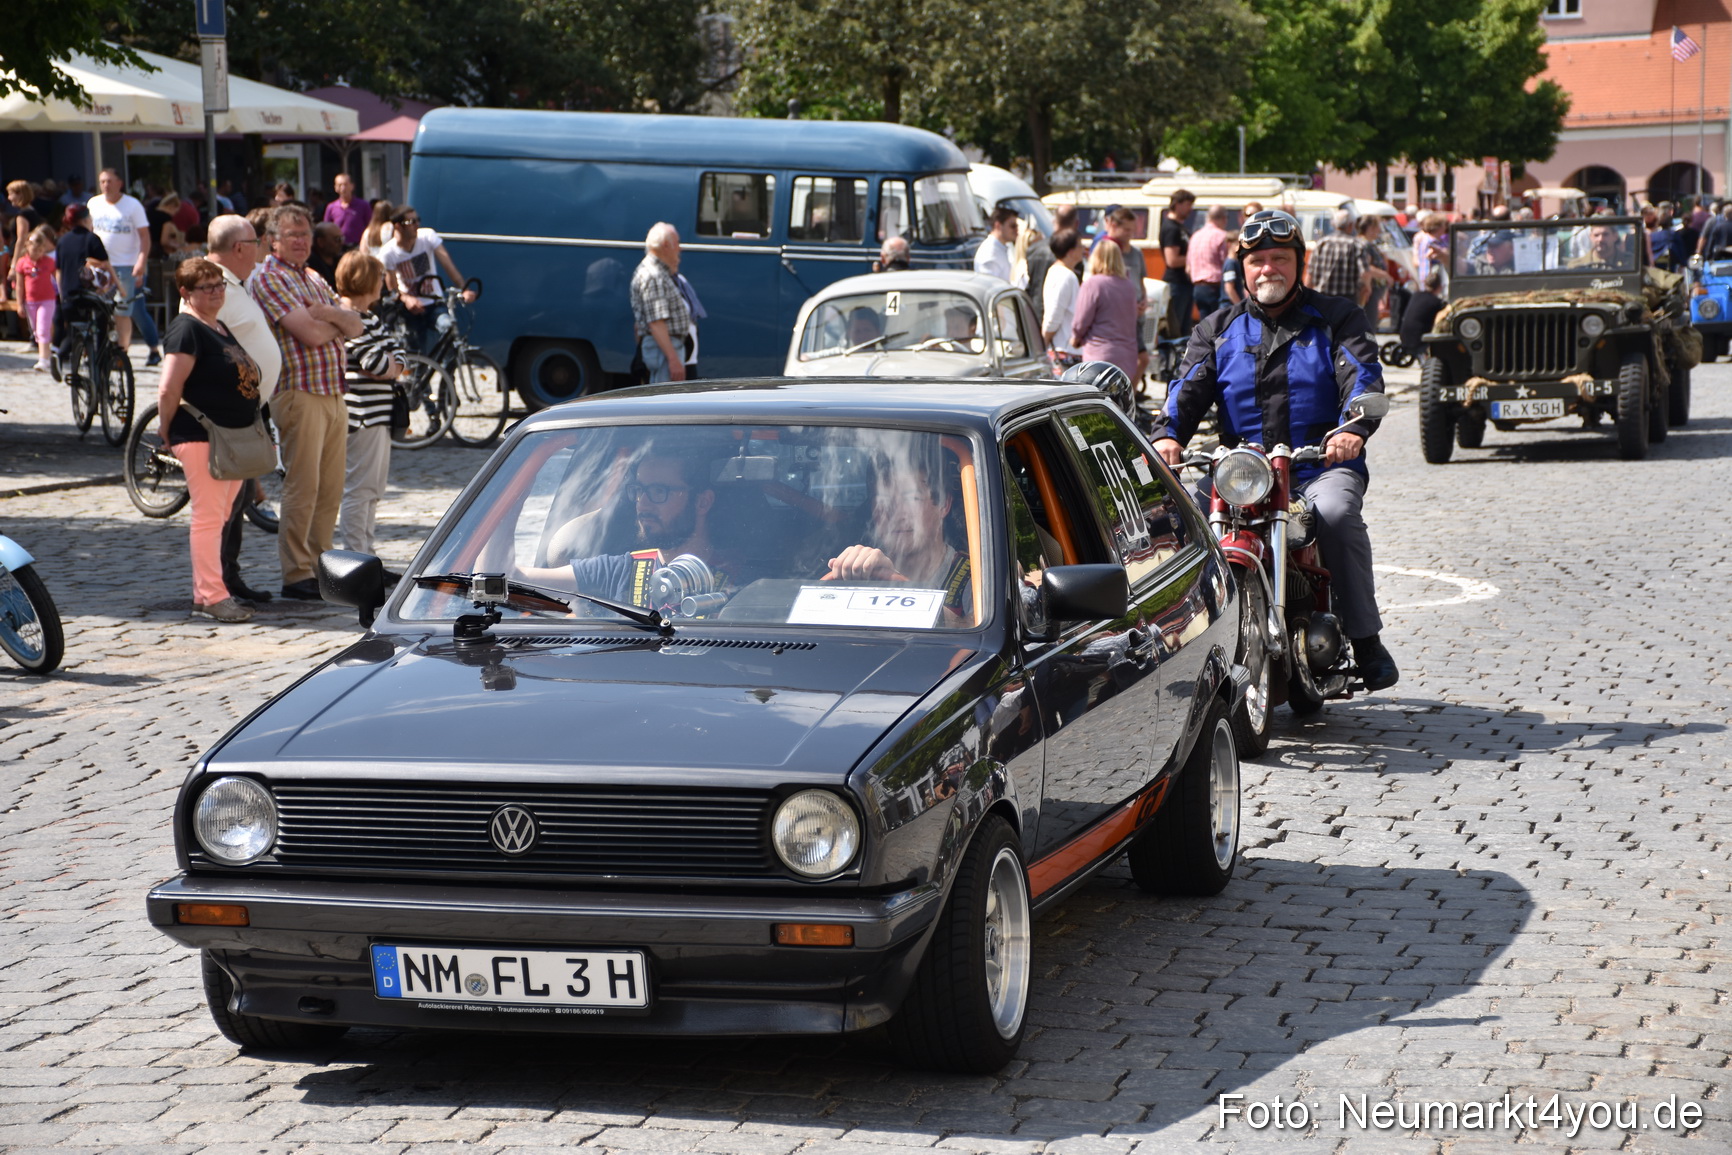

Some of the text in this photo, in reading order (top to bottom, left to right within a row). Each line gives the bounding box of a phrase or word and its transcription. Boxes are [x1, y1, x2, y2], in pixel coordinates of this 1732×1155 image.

[888, 295, 897, 312] 4
[1503, 402, 1560, 416] R X 50 H
[868, 595, 916, 607] 176
[383, 953, 637, 999] D NM FL 3 H
[464, 1004, 493, 1012] Rebmann
[498, 1006, 550, 1014] Trautmannshofen
